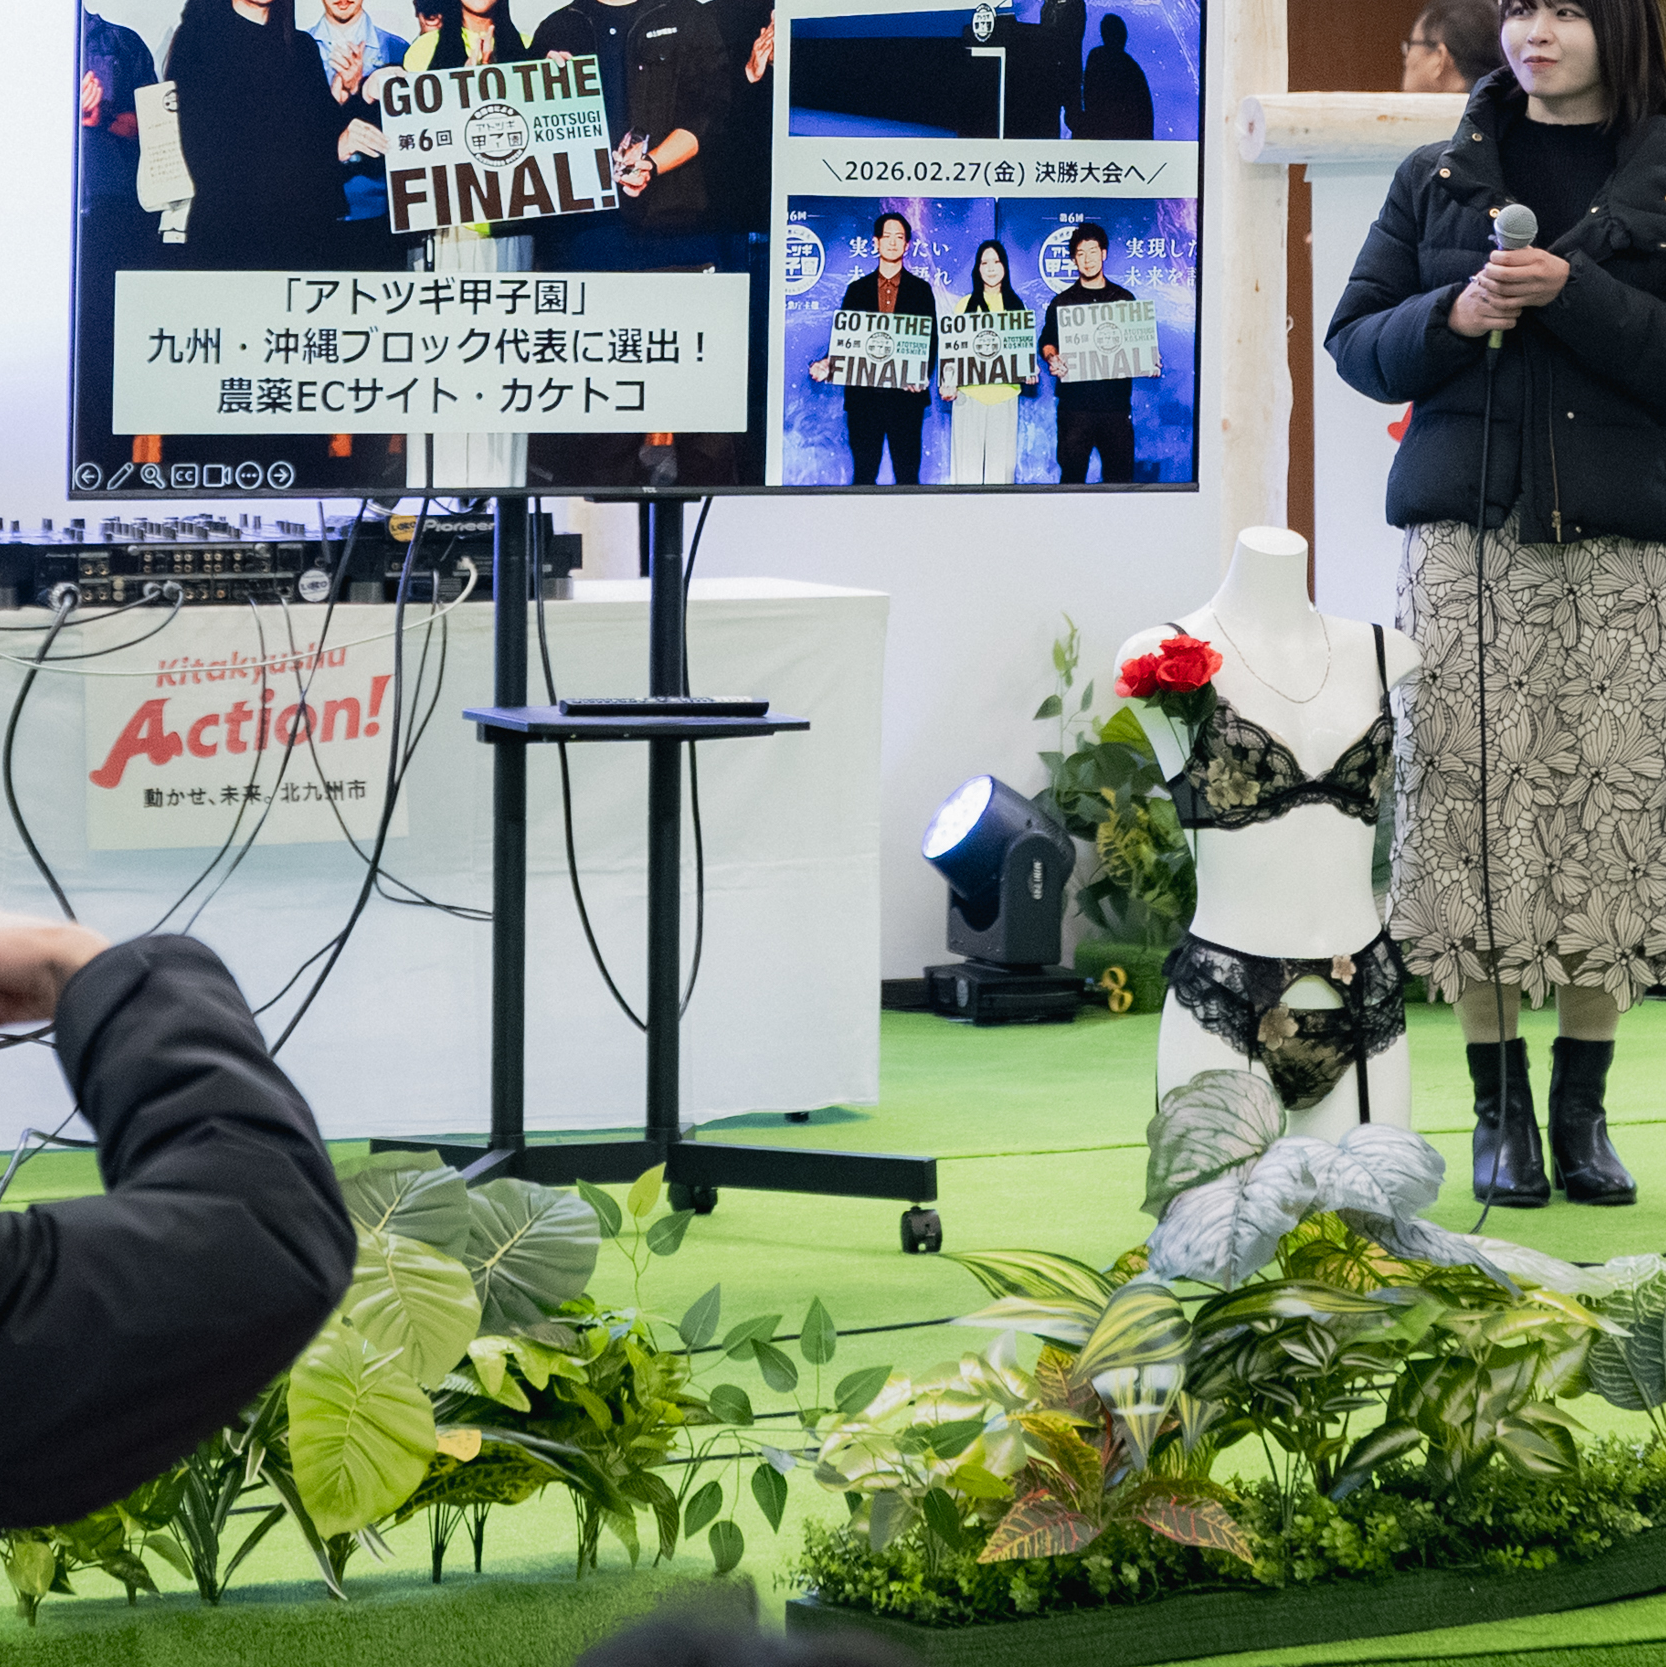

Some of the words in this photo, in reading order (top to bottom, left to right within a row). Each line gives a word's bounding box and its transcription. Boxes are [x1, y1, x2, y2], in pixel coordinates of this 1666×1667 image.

[383, 73, 443, 117] GO
[449, 67, 507, 109] TO
[513, 57, 601, 102] THE
[533, 110, 601, 130] ATOTSUGI
[398, 128, 453, 151] 第6回
[535, 123, 603, 144] KOSHIEN
[389, 147, 617, 231] FINAL!
[788, 210, 808, 221] 6回
[787, 245, 813, 257] トツギ
[786, 256, 820, 276] 子園
[1045, 258, 1079, 278] 甲子
[284, 278, 590, 317] 「アトツギ甲子園」
[834, 311, 861, 332] GO
[866, 313, 890, 333] TO
[894, 316, 933, 337] THE
[940, 315, 966, 334] GO
[969, 313, 994, 332] TO
[997, 311, 1036, 331] THE
[1059, 307, 1086, 328] GO
[1088, 304, 1114, 325] TO
[1115, 301, 1155, 323] THE
[146, 326, 707, 367] 九州・沖縄ブロック代表に選出！
[216, 378, 646, 415] 農薬ECサイト・カケトコ
[422, 519, 496, 533] Pioneer
[155, 642, 348, 689] Kitakyushu
[88, 674, 393, 790] Action!
